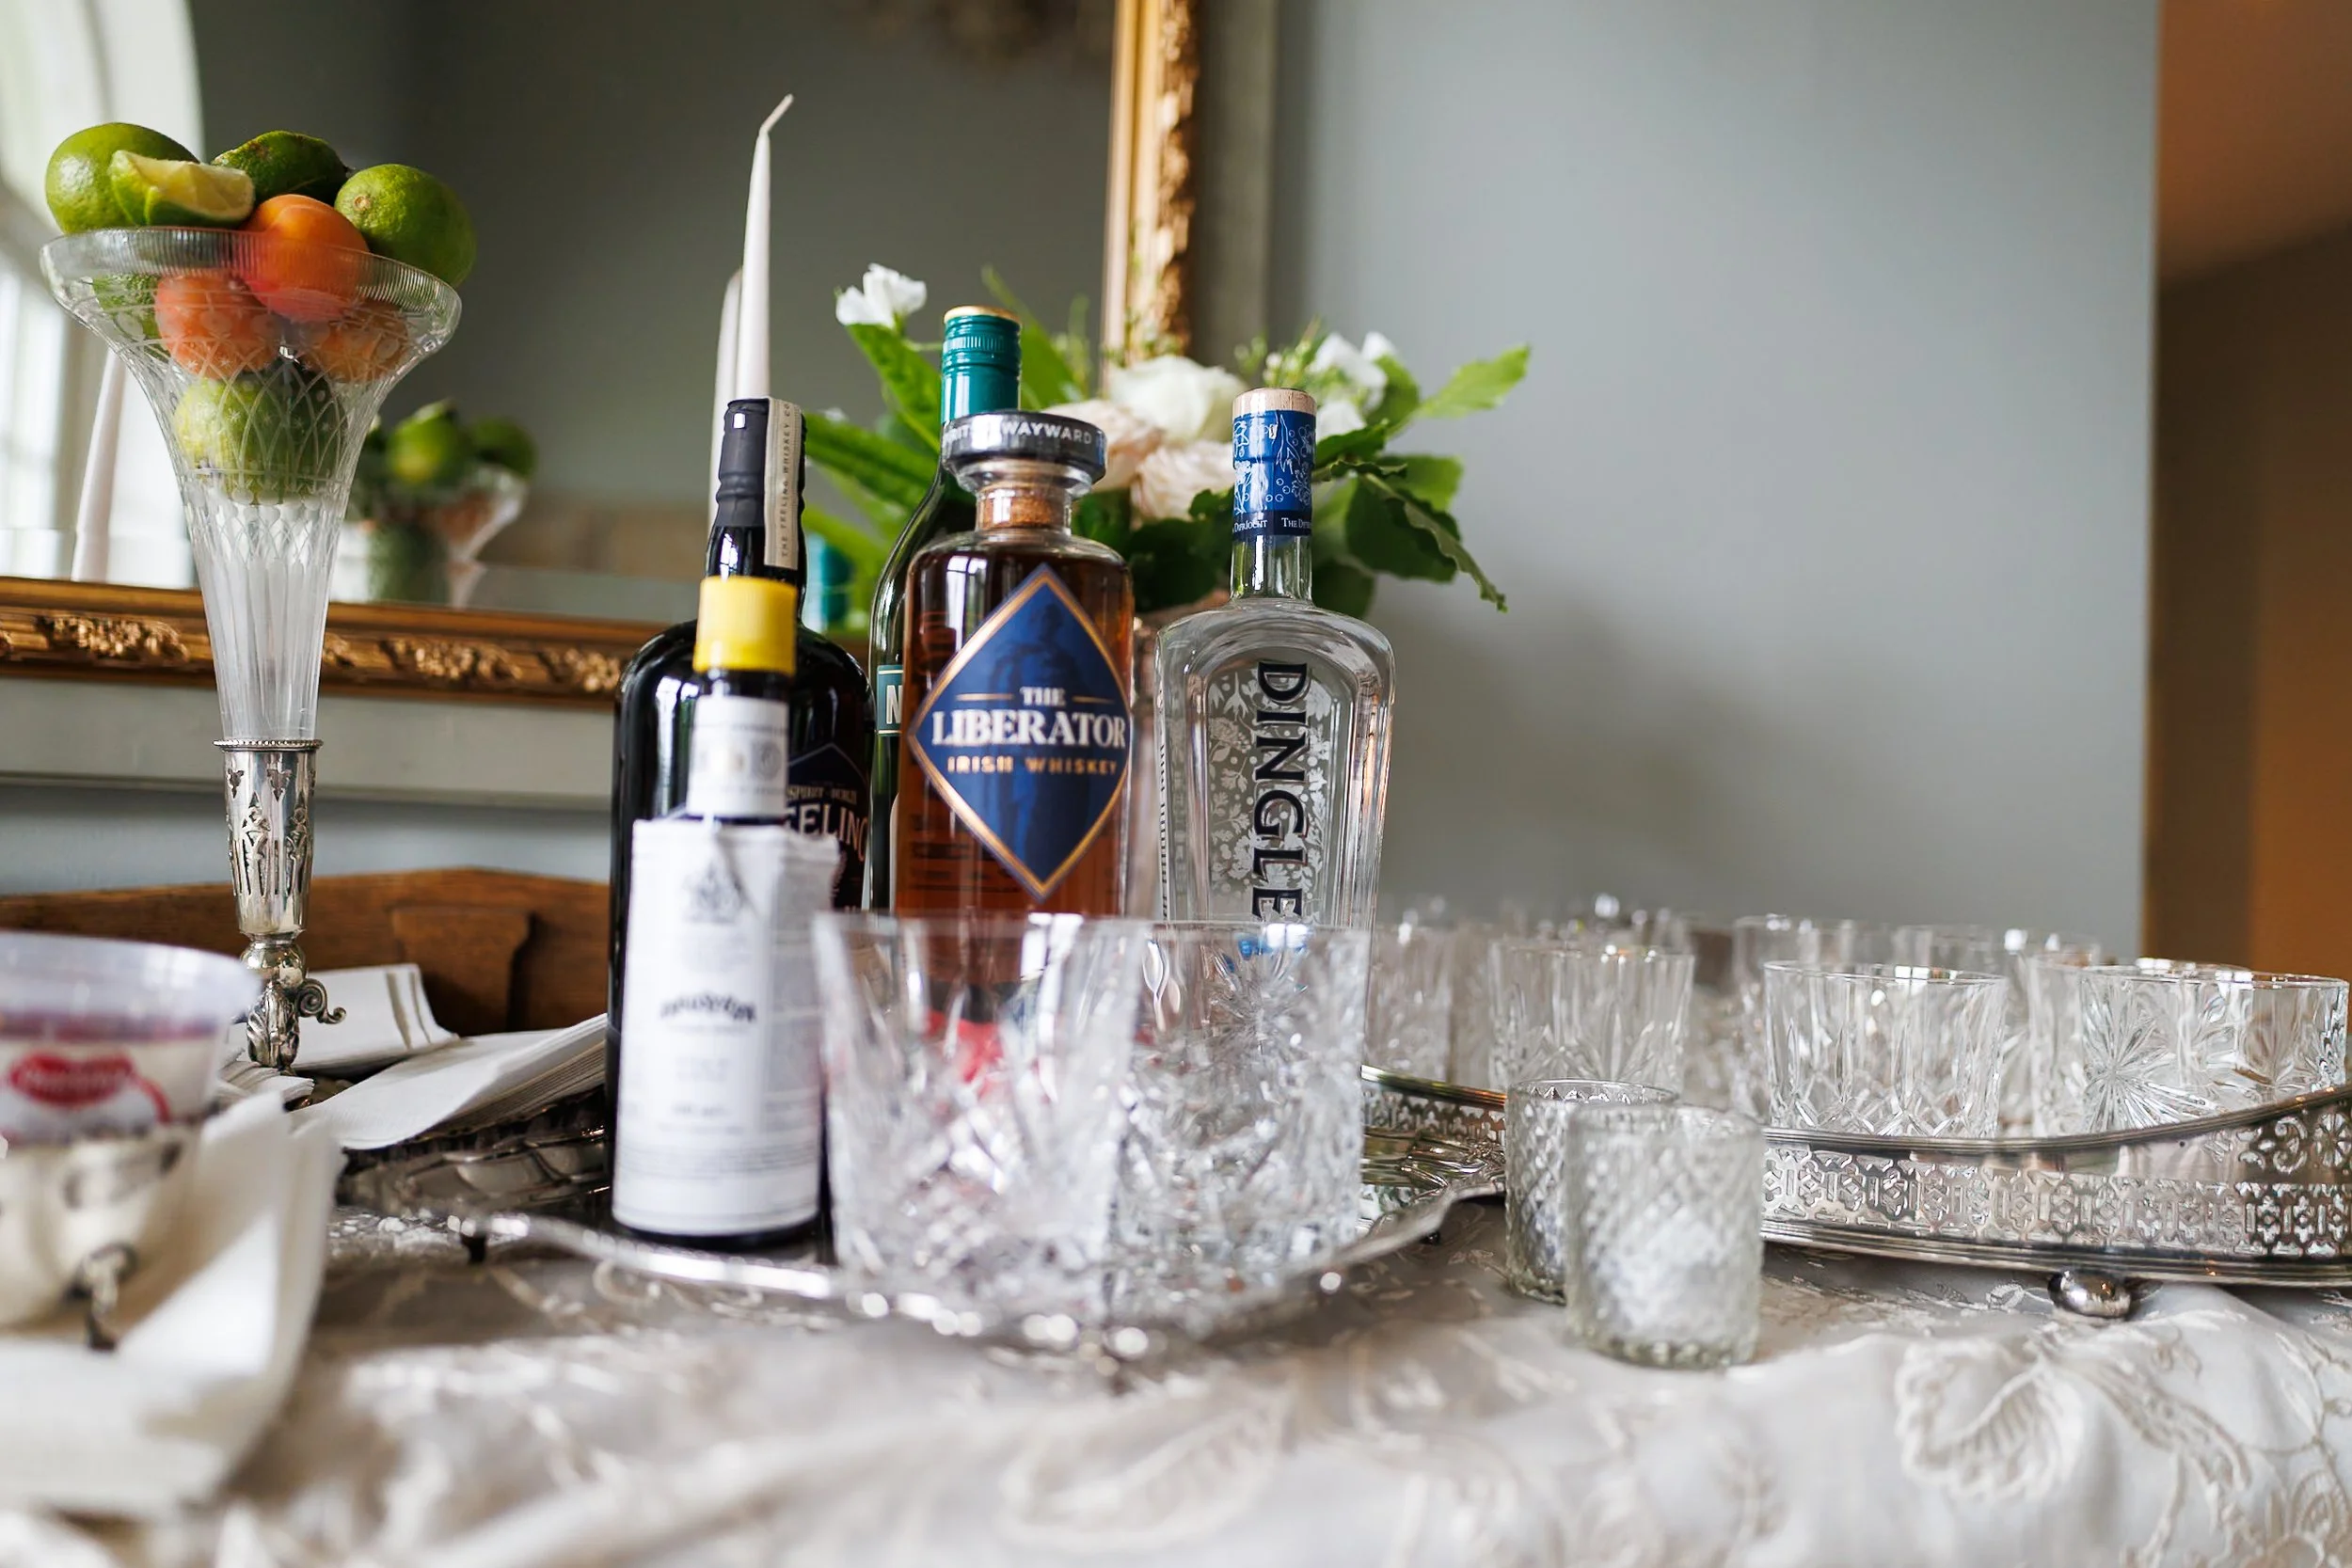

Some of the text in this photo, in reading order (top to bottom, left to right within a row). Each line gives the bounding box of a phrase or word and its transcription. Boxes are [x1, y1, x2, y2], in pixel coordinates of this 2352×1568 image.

[782, 423, 791, 473] WHISKEY
[1002, 422, 1092, 445] WAYWARD
[780, 482, 789, 530] TEELING
[1020, 687, 1065, 706] THE
[931, 709, 1125, 748] LIBERATOR
[947, 755, 1117, 775] IRISH WHISKEY
[1252, 661, 1309, 919] DINGLE
